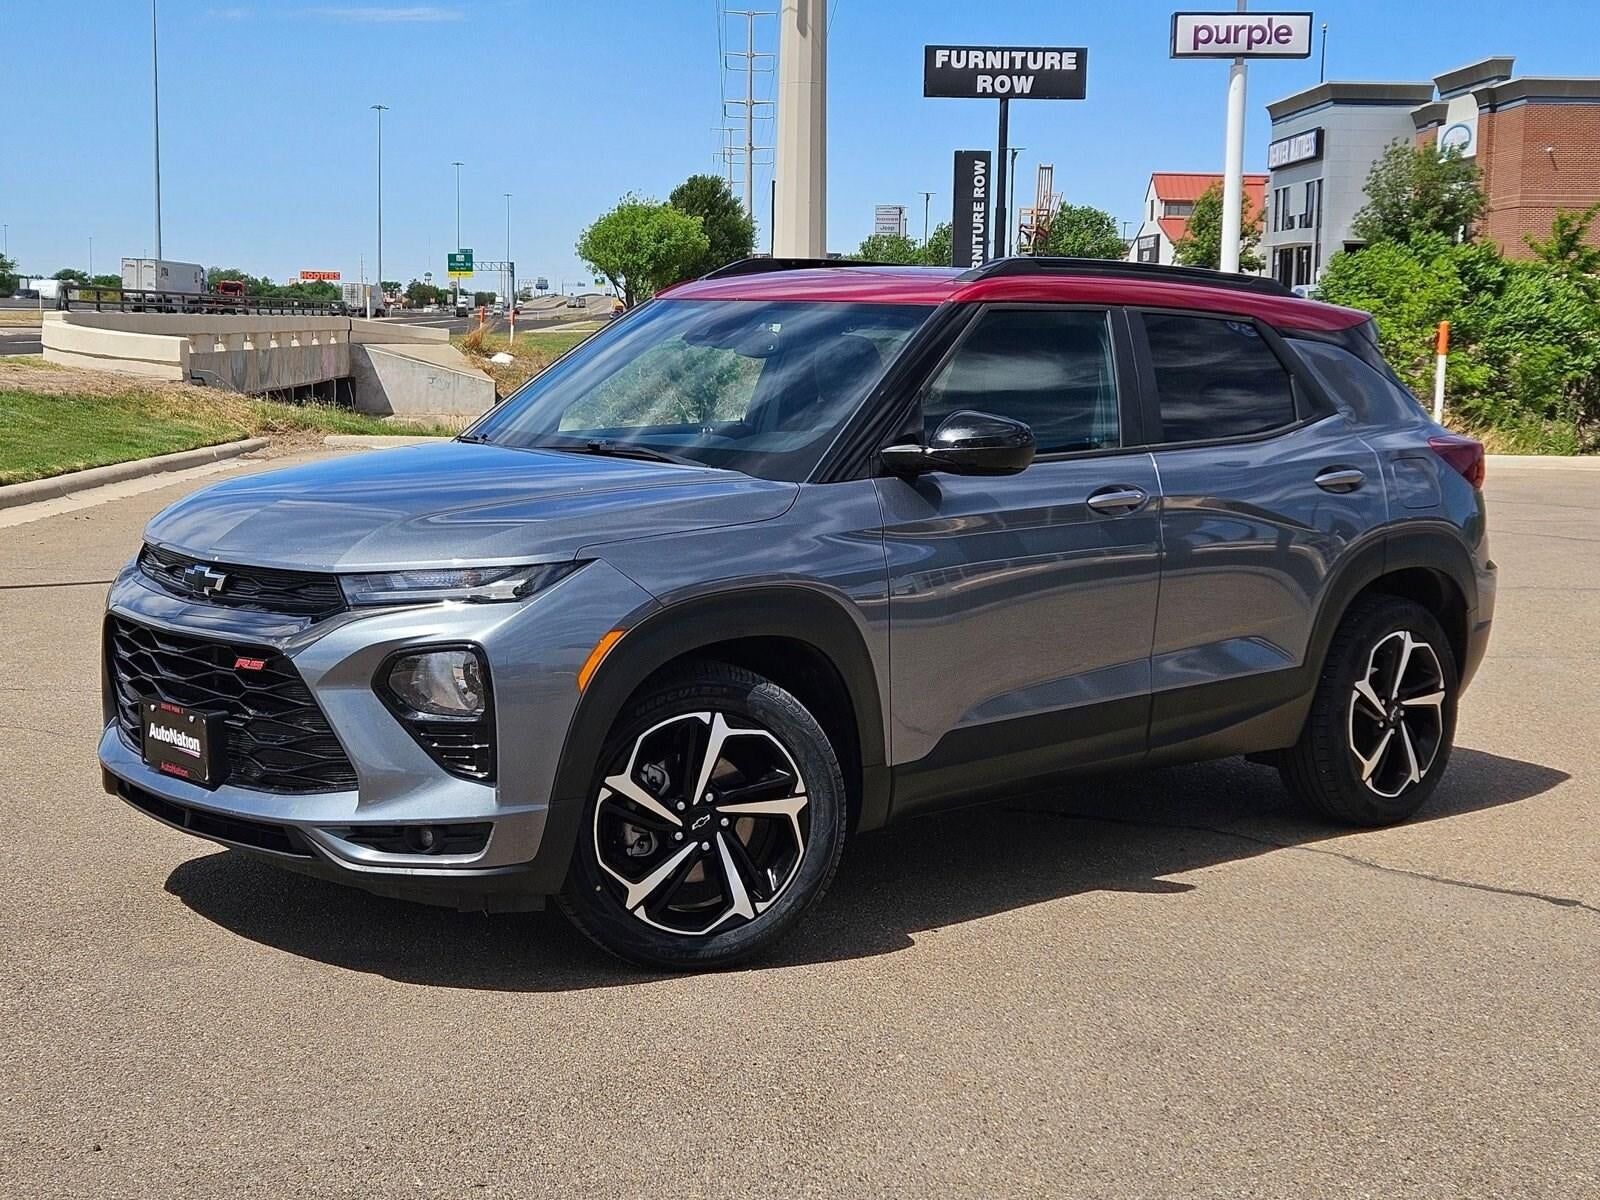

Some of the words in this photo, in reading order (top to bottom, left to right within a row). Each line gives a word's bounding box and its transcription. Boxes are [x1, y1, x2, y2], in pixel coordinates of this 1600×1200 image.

[1192, 17, 1294, 51] purple
[935, 49, 1077, 71] FURNITURE
[976, 74, 1035, 94] ROW
[973, 160, 986, 198] ROW
[880, 224, 895, 232] Jeep
[971, 201, 985, 271] RNITURE
[301, 271, 340, 280] HOOTERS
[235, 658, 264, 670] RS
[149, 722, 201, 752] AutoNation
